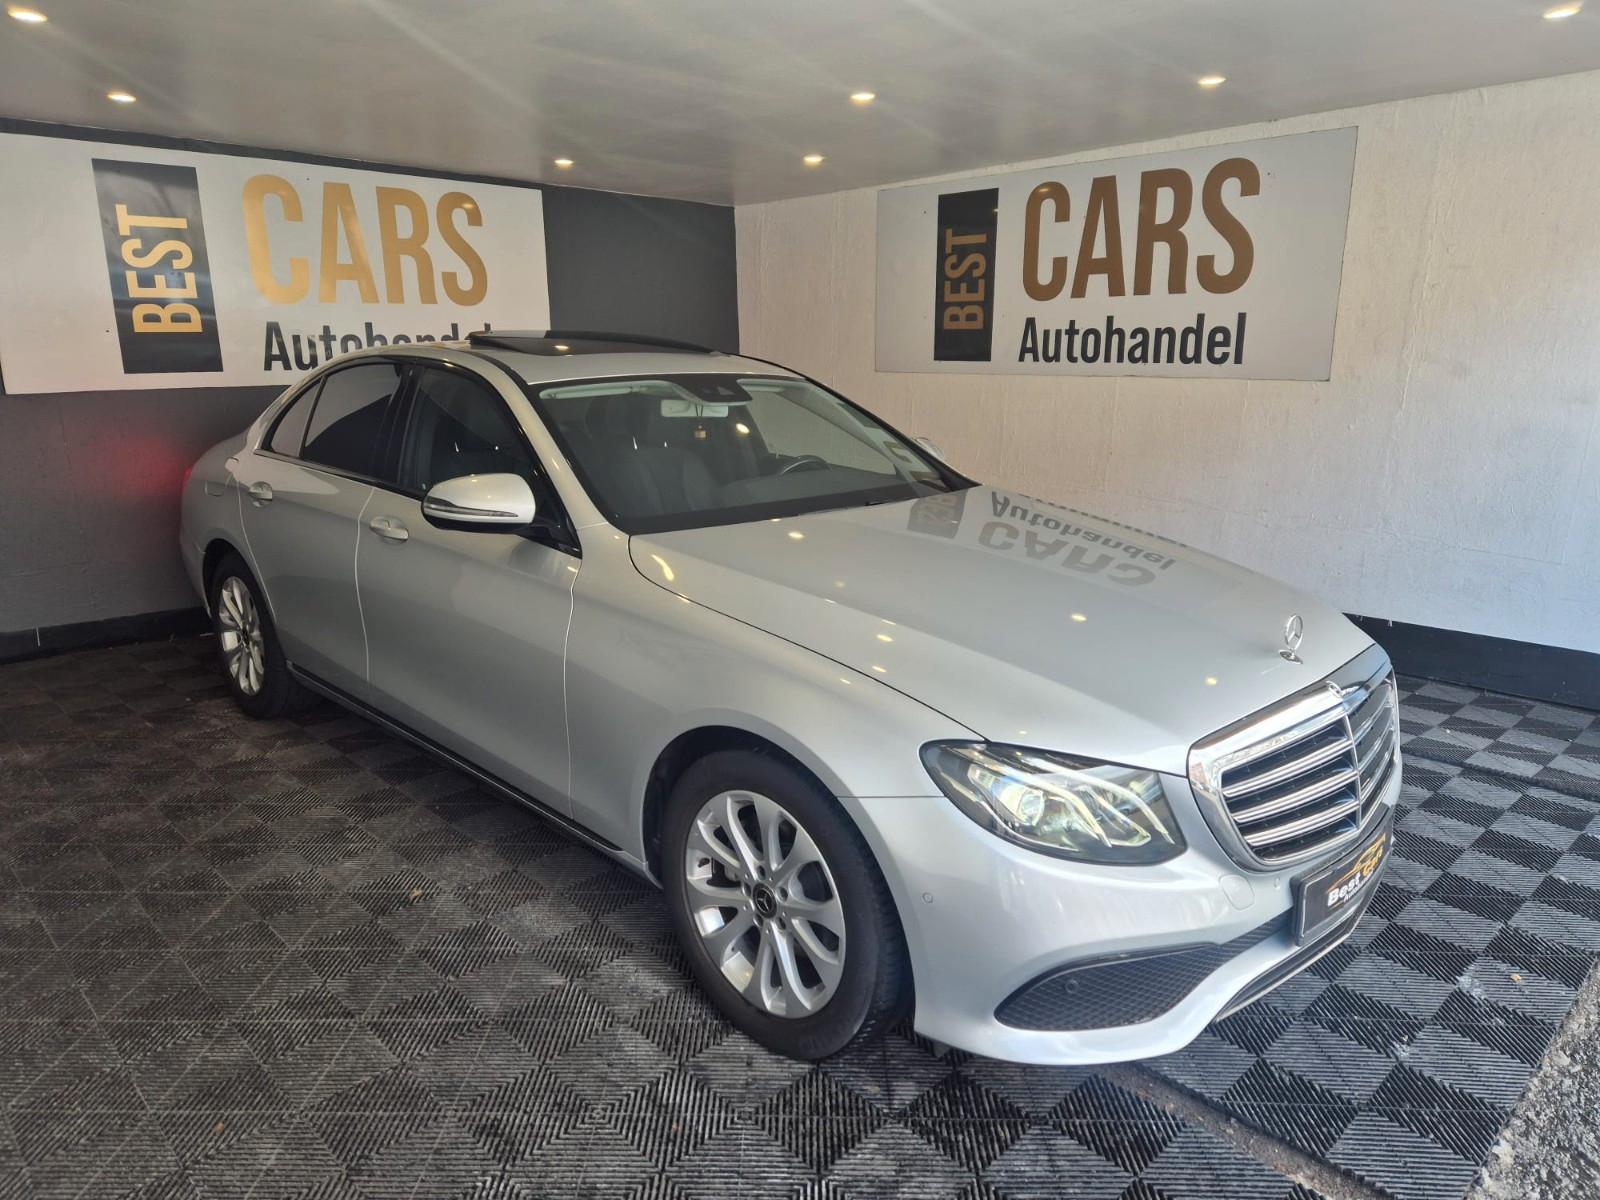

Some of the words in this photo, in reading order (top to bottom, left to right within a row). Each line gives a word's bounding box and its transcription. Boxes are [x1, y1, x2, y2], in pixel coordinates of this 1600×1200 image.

[115, 204, 203, 333] BEST
[242, 174, 489, 307] CARS
[943, 228, 987, 331] BEST
[1022, 157, 1261, 301] CARS
[1018, 312, 1247, 365] Autohandel
[1327, 871, 1361, 908] Best
